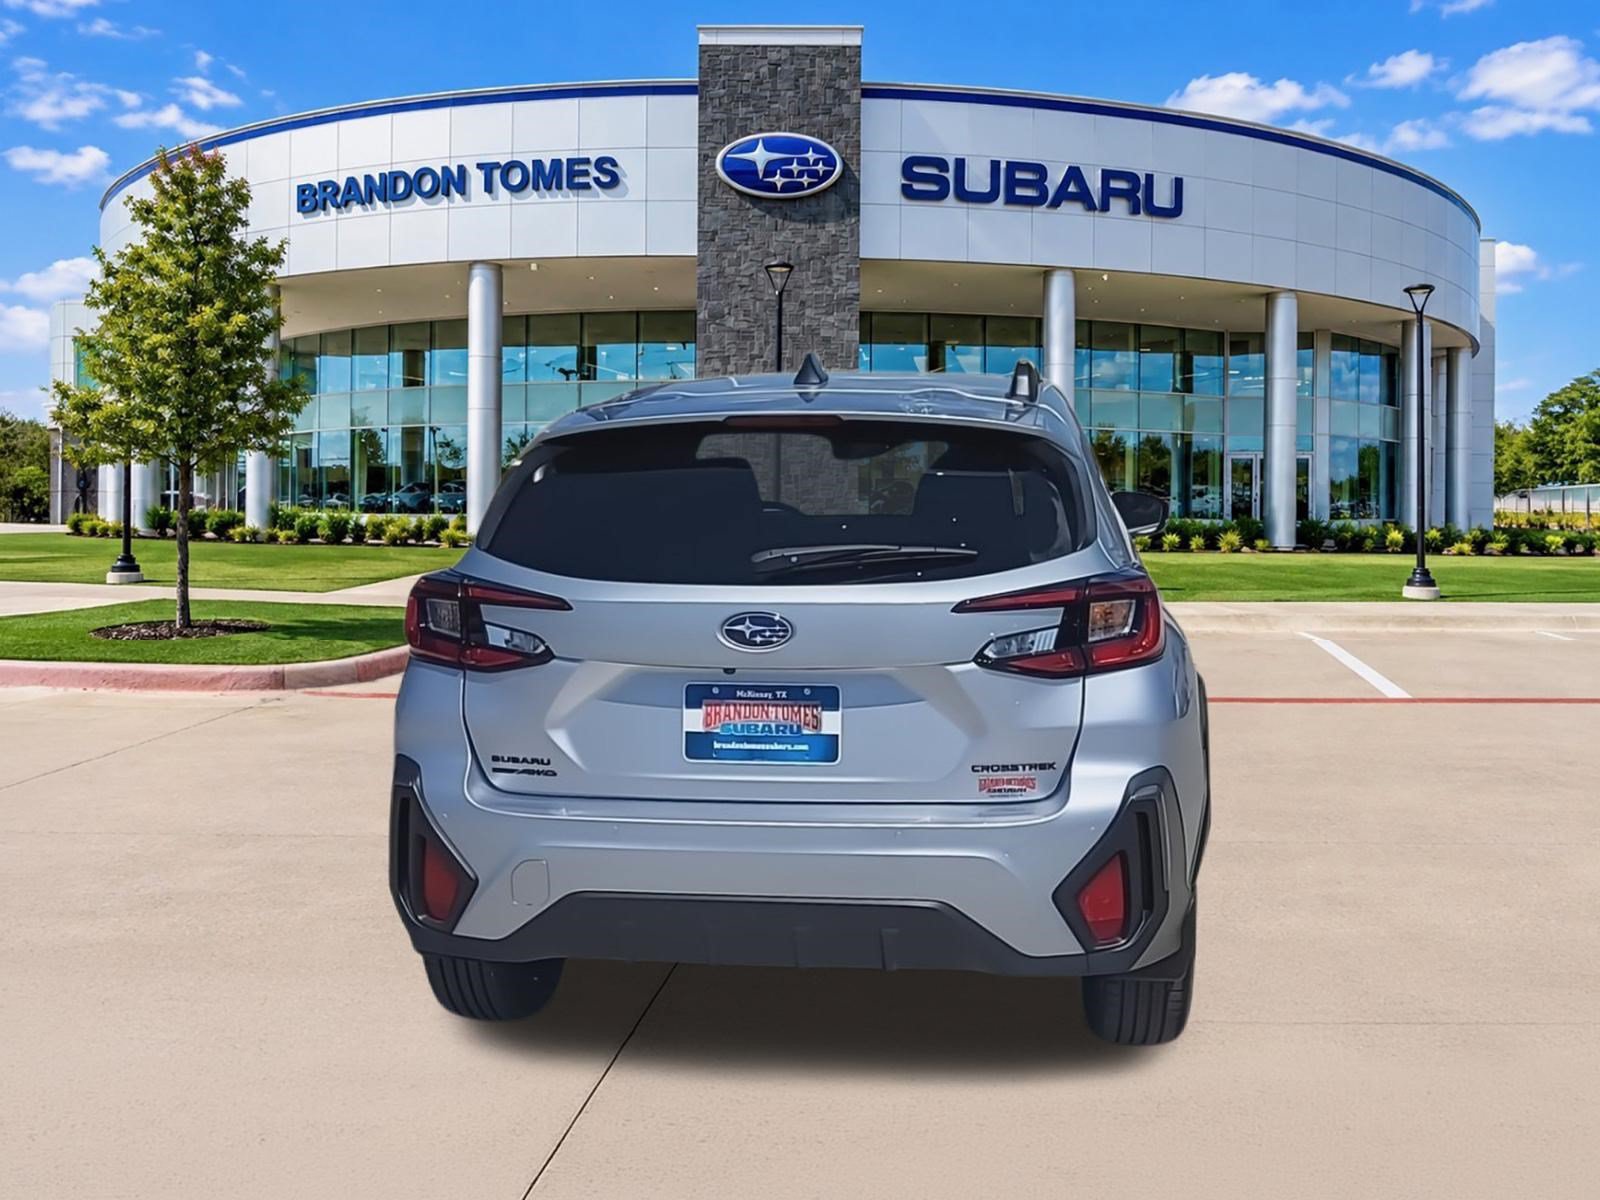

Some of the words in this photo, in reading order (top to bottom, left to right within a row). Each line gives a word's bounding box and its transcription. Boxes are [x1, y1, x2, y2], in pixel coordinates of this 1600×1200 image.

[296, 166, 467, 214] BRANDON
[476, 156, 620, 194] TOMES
[900, 155, 1184, 218] SUBARU
[720, 723, 802, 735] SUBARU
[491, 755, 551, 766] SUBARU
[971, 762, 1056, 773] CROSSTREK
